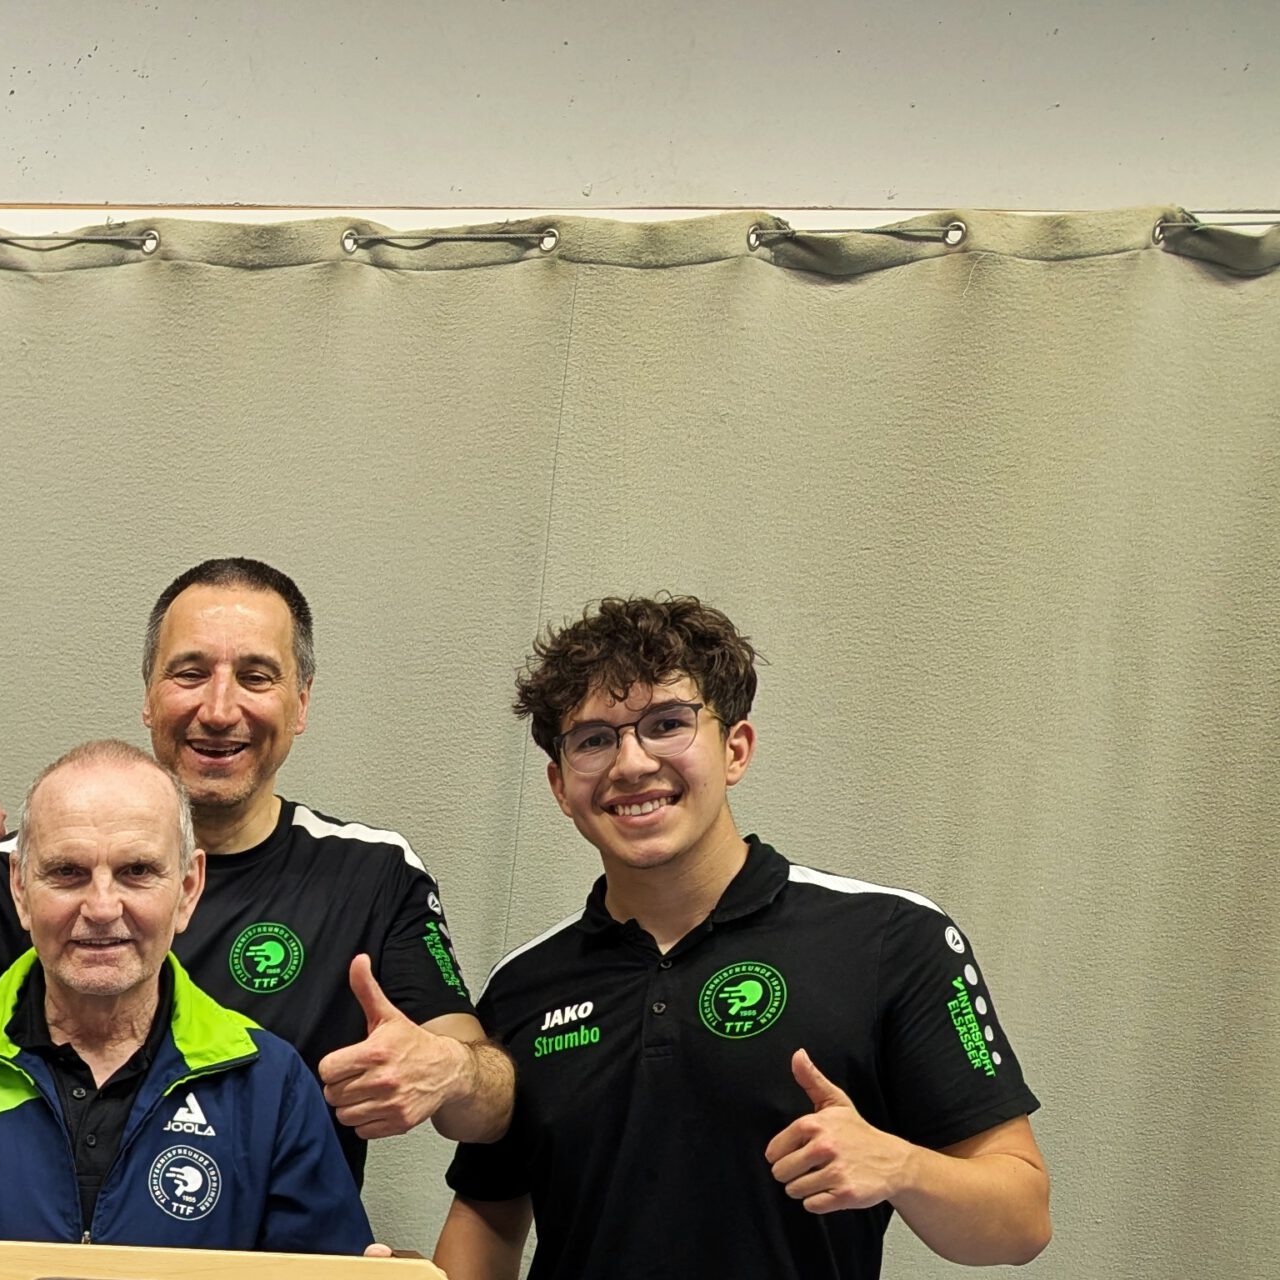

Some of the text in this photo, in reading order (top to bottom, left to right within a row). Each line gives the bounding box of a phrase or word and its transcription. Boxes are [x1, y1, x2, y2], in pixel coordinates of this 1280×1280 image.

[252, 977, 280, 989] TTF
[703, 965, 773, 1027] TISCHTENNISFREUNDE
[540, 1001, 594, 1031] JAKO
[724, 1020, 755, 1034] TTF
[534, 1024, 600, 1058] Strambo
[956, 990, 997, 1077] INTERSPORT
[162, 1120, 217, 1137] JOOLA
[151, 1148, 210, 1205] TISCHTENNISFREUNDE
[171, 1201, 195, 1216] TTF
